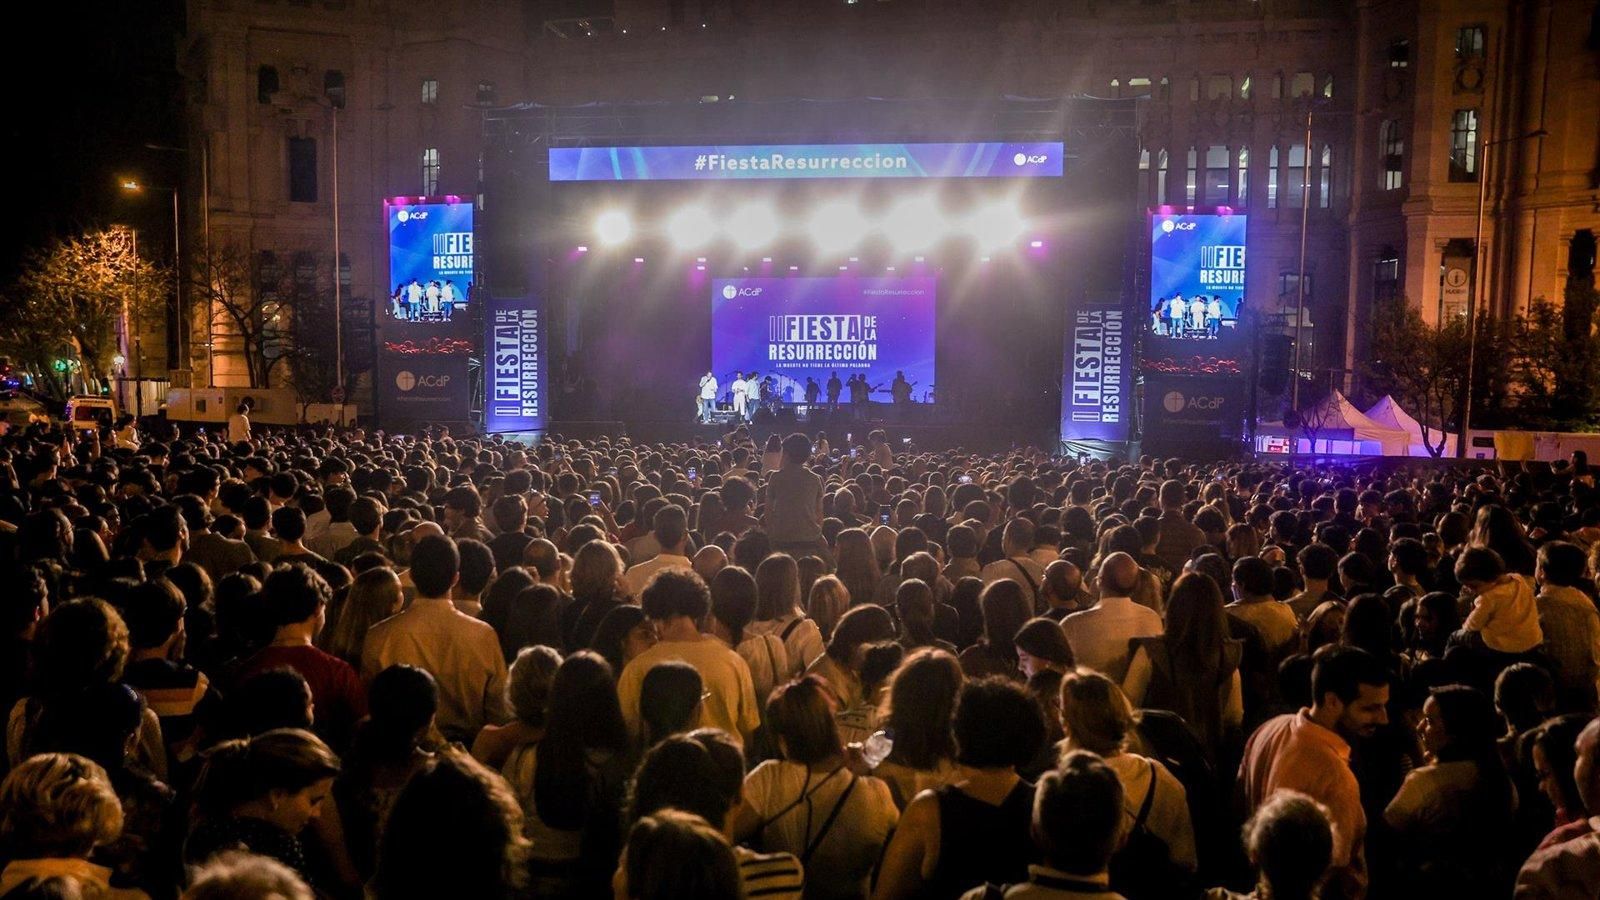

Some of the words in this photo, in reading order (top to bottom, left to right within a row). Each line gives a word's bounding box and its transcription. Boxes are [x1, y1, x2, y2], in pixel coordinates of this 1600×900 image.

[694, 153, 907, 170] #FiestaResurreccion
[1027, 155, 1047, 163] ACdP
[1175, 222, 1196, 230] ACdP
[738, 287, 762, 296] ACdP
[496, 310, 507, 322] DE
[507, 310, 519, 322] LA
[864, 316, 877, 327] DE
[1077, 310, 1089, 323] DE
[1089, 310, 1102, 323] LA
[785, 315, 861, 342] FIESTA
[864, 329, 877, 341] LA
[768, 341, 877, 360] RESURRECCIÓN
[495, 325, 520, 401] FIESTA
[520, 309, 538, 416] RESURRECCIÓN
[1073, 326, 1103, 405] FIESTA
[1102, 310, 1123, 422] RESURRECCIÓN
[418, 375, 450, 387] ACdP
[1187, 397, 1225, 409] ACdP
